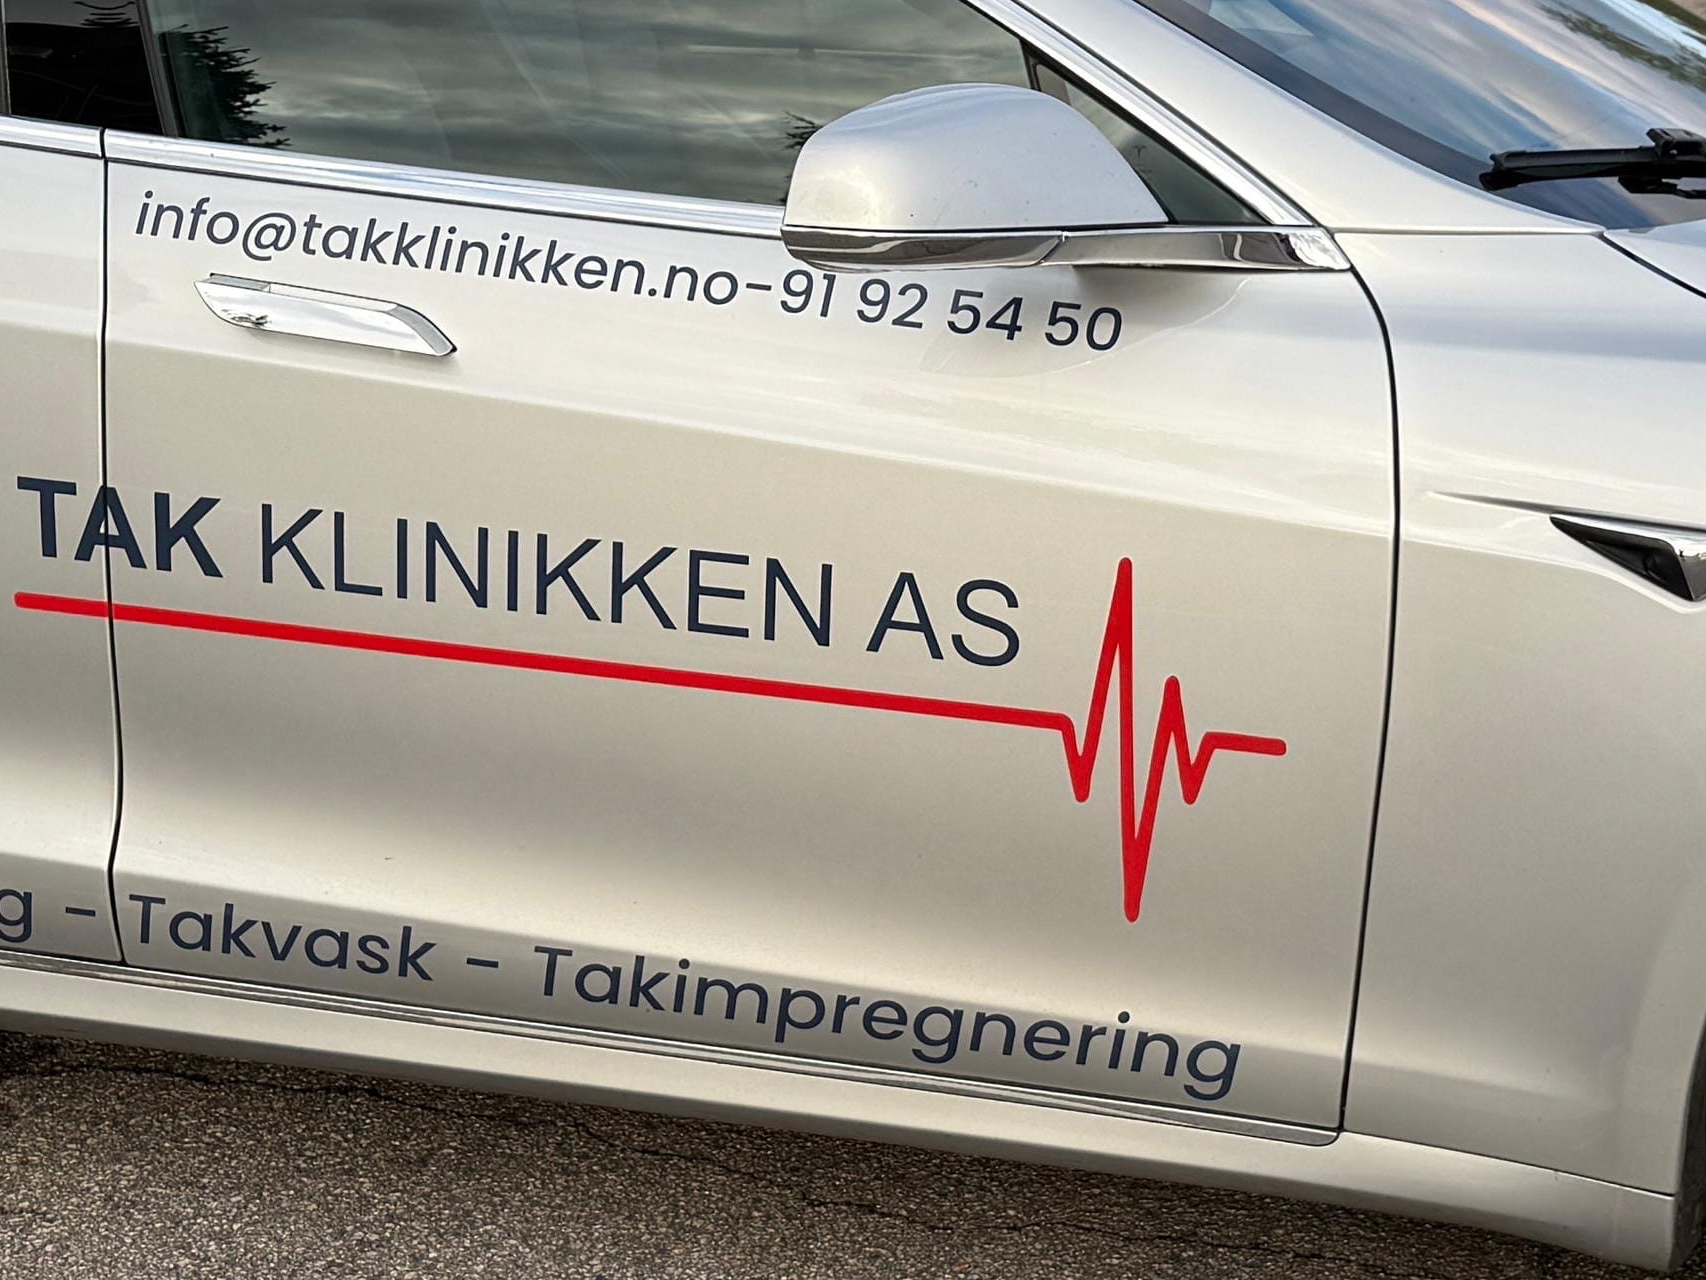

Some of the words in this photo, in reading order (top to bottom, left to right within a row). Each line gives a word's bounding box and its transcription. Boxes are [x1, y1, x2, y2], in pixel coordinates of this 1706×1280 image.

[856, 277, 925, 330] 92
[946, 289, 1024, 341] 54
[1044, 303, 1123, 353] 50
[15, 475, 225, 579] TAK
[259, 505, 833, 650] KLINIKKEN
[866, 570, 1022, 668] AS
[129, 894, 437, 982] Takvask
[534, 945, 1242, 1101] Takimpregnering
